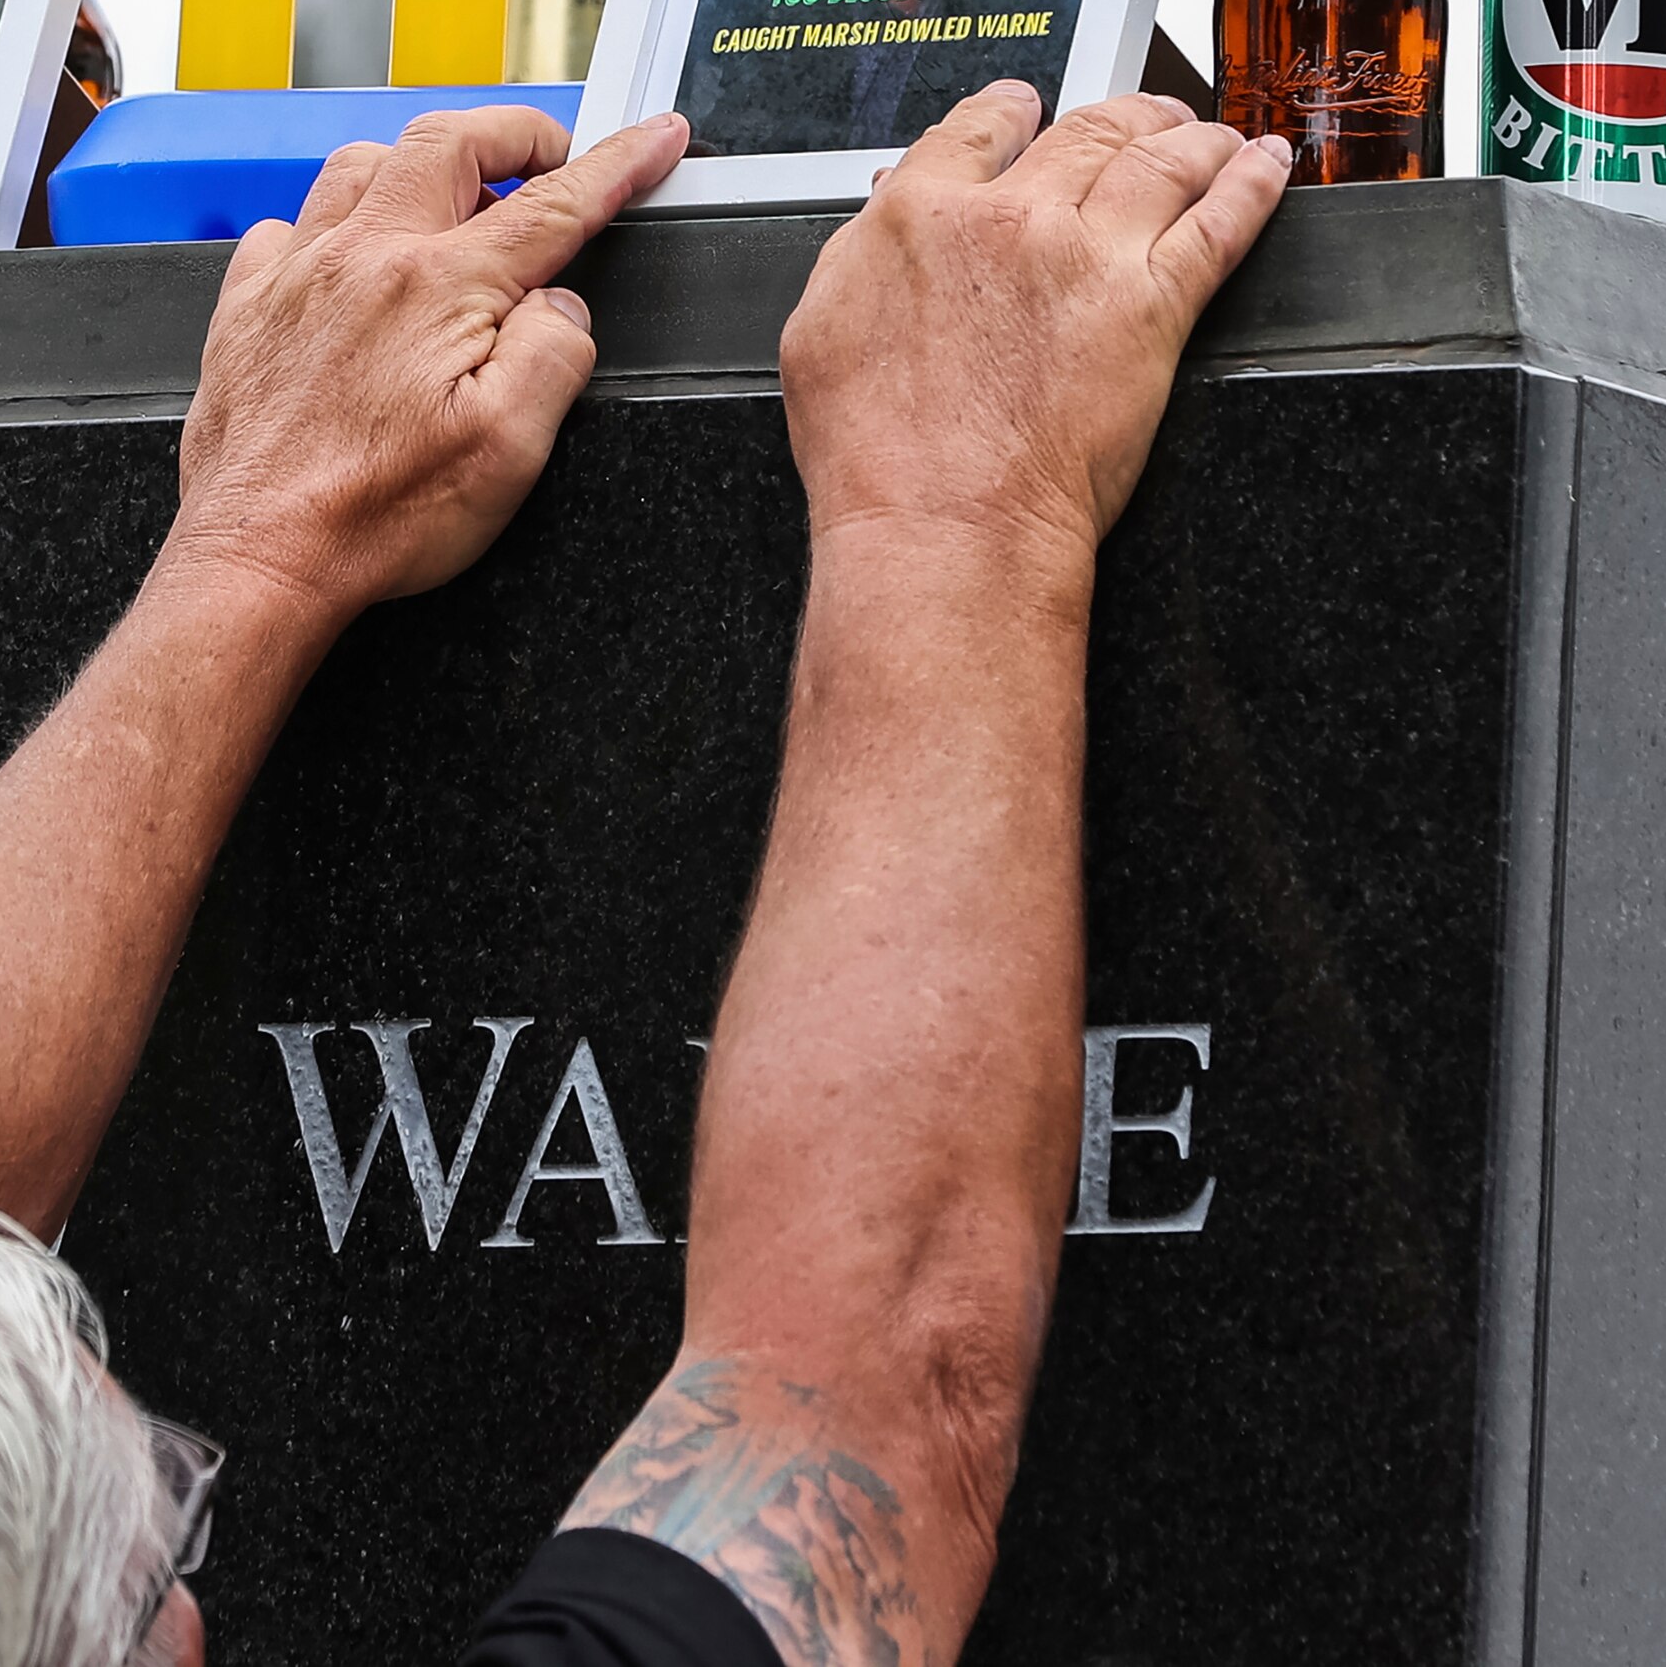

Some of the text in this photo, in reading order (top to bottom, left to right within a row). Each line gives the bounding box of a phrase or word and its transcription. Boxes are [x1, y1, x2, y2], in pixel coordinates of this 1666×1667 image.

[712, 11, 1054, 54] CAUGHT MARSH BOWLED WARNE
[257, 1016, 1216, 1254] WAE
